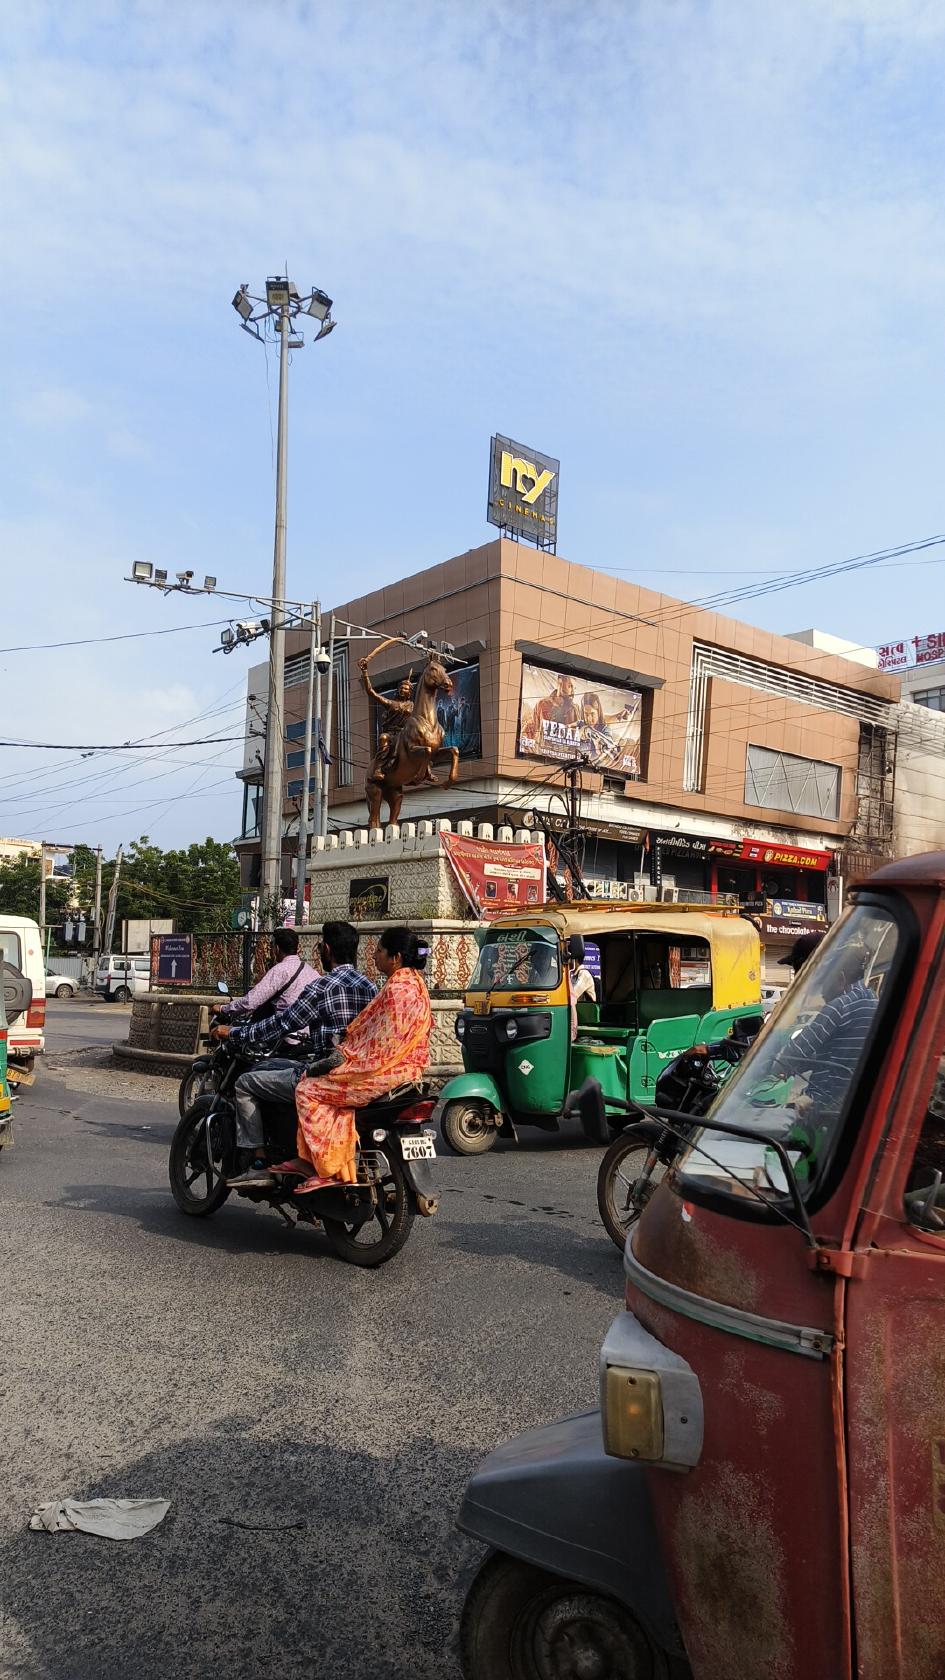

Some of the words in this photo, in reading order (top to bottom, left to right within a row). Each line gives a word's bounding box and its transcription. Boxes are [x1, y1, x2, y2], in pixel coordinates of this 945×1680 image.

[498, 499, 555, 525] CINEMAS
[542, 719, 581, 742] VEDAA
[774, 852, 818, 866] PIZZA.COM
[404, 1146, 432, 1159] 7607
